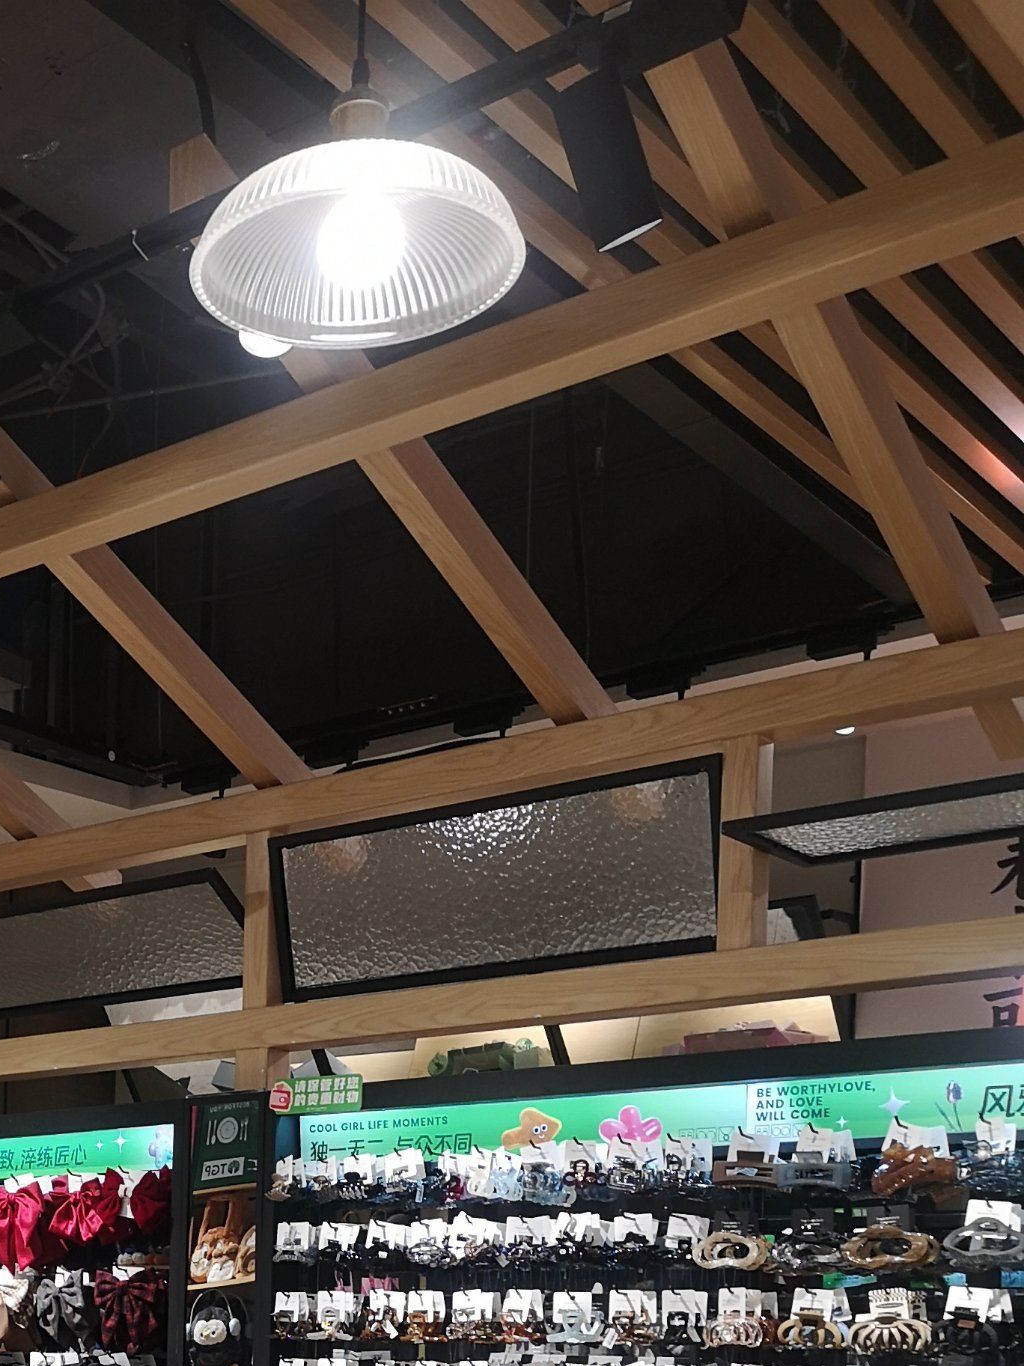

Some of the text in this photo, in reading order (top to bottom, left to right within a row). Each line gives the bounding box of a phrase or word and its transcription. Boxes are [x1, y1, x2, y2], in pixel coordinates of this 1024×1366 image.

[756, 1080, 876, 1098] BE WORTHYLOVE,
[756, 1096, 823, 1109] AND LOVE
[755, 1107, 831, 1121] WILL COME
[309, 1115, 448, 1133] COOL GIRL LIFE MOMENTS
